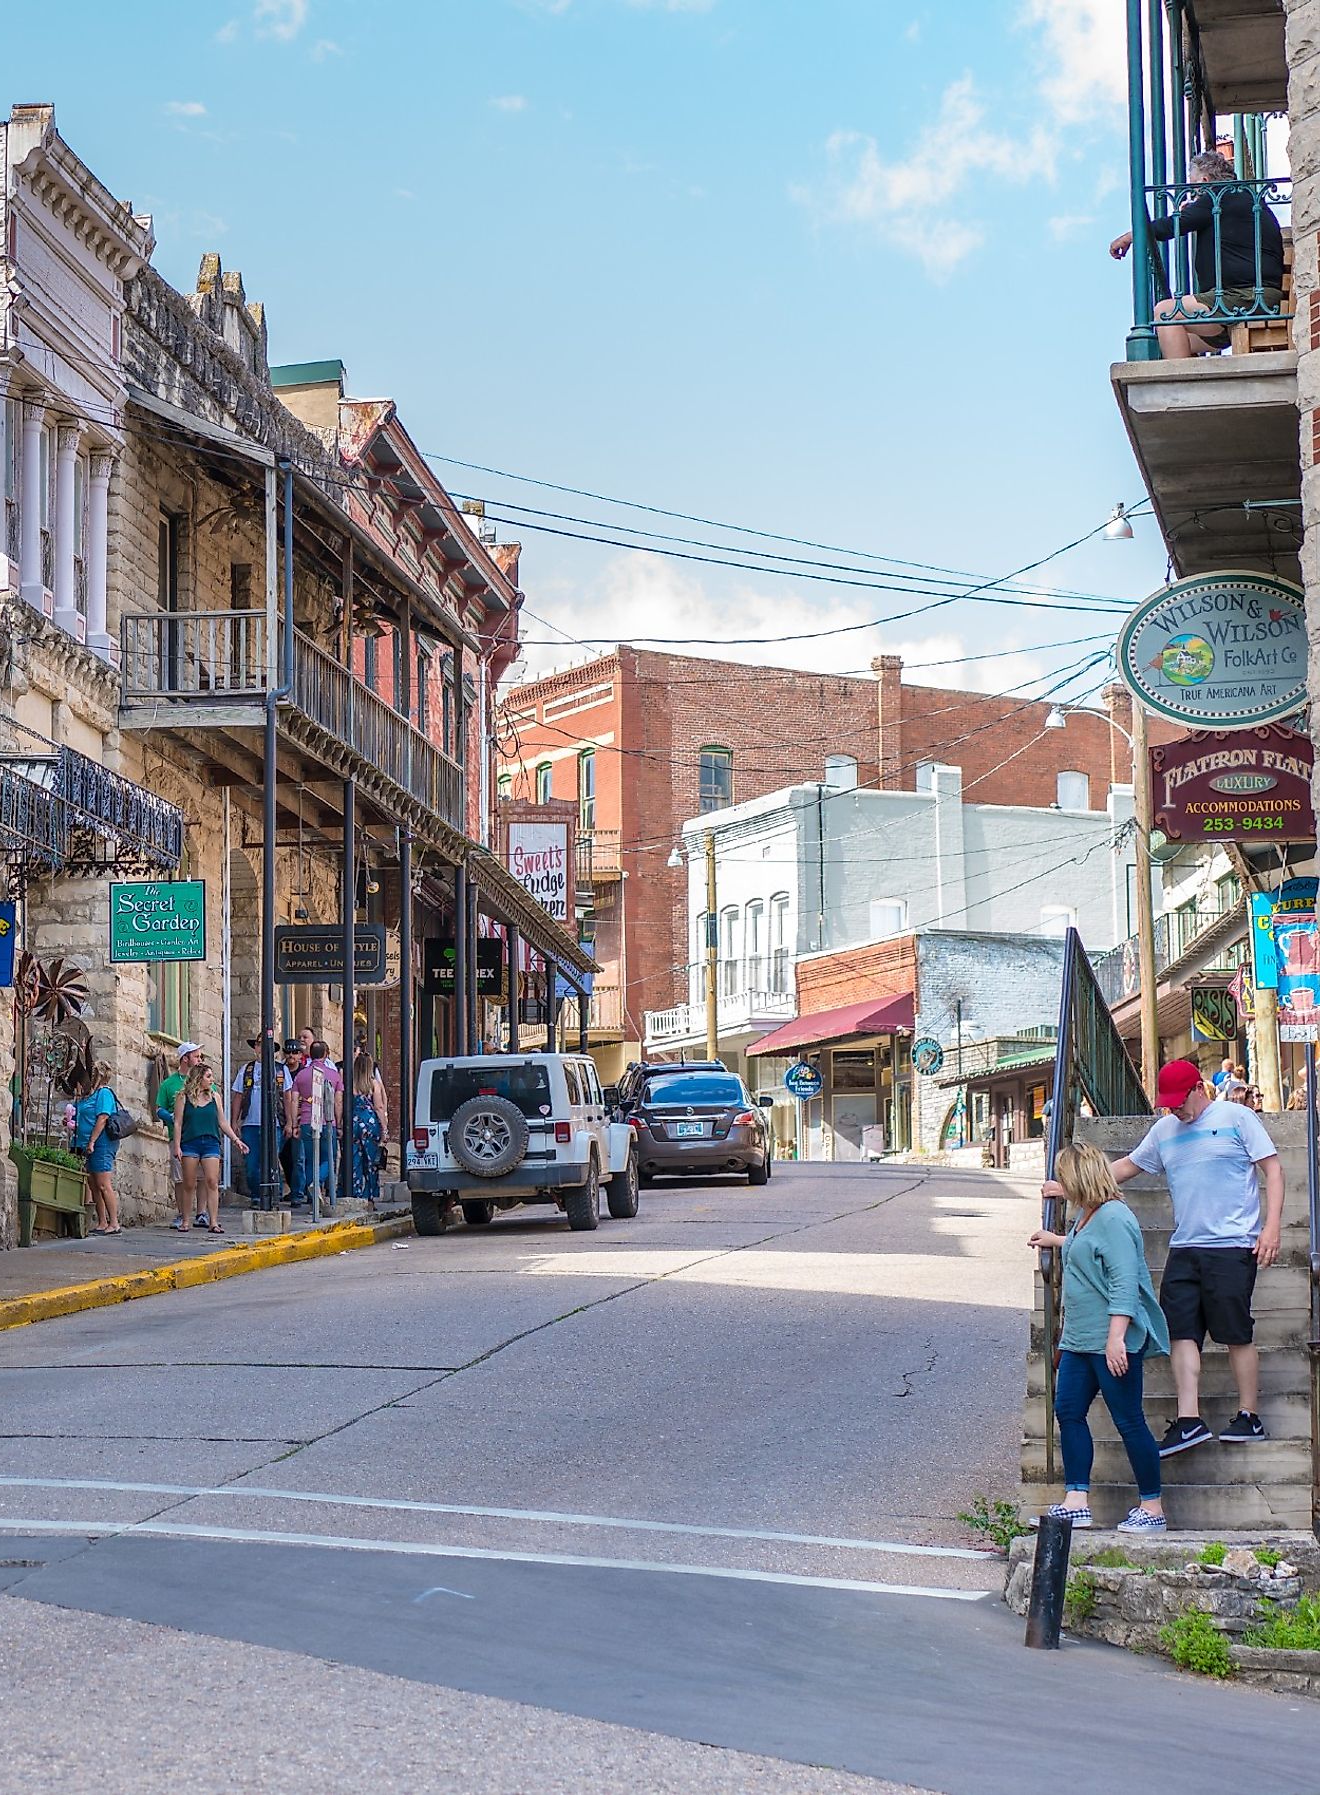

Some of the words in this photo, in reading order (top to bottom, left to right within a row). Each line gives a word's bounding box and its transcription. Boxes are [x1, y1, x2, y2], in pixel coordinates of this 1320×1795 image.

[1150, 594, 1246, 635] WILSON
[1247, 599, 1263, 619] &
[1203, 614, 1301, 646] WILSON
[1180, 689, 1202, 701] TRUE
[1206, 686, 1256, 700] AMERICANA
[1259, 683, 1277, 696] ART
[1161, 749, 1258, 808] FLATIRON
[1262, 749, 1313, 784] FLAT
[1216, 776, 1272, 789] LUXURY
[1185, 799, 1302, 814] ACCOMMODATIONS
[1203, 816, 1284, 832] 253-9434
[513, 845, 562, 876] Sweet's
[144, 885, 160, 896] The
[116, 894, 175, 914] Secret
[132, 912, 200, 936] Garden
[187, 938, 199, 946] Art
[280, 940, 321, 953] HOUSE
[354, 943, 378, 952] TYLE
[114, 948, 139, 958] Jewelry
[385, 951, 400, 961] sels
[285, 959, 323, 968] APPAREL
[330, 959, 373, 968] UNUES
[432, 968, 455, 979] TEE
